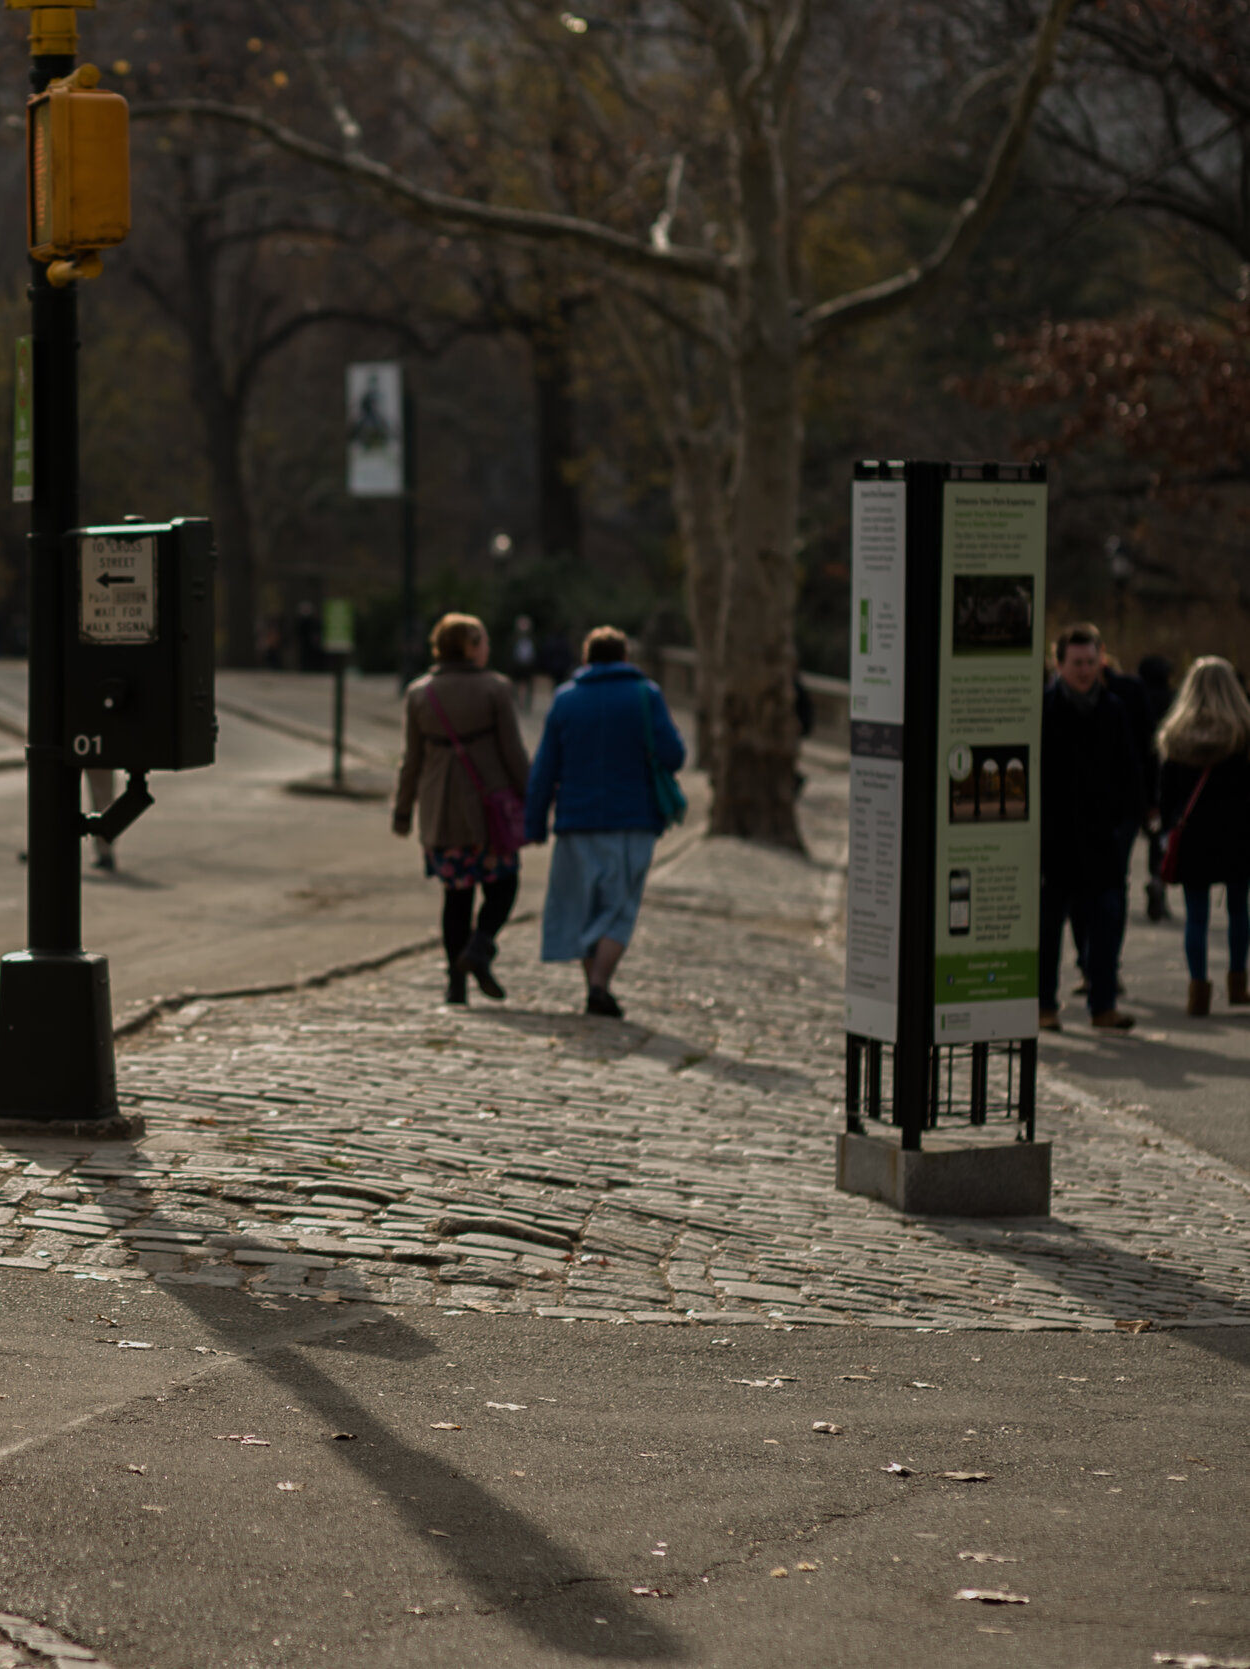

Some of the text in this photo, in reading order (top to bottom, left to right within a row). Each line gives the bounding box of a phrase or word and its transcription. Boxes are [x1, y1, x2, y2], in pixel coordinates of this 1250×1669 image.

[98, 556, 135, 568] STREET
[88, 591, 110, 602] PUSH
[94, 606, 142, 617] WAIT FOR
[85, 621, 149, 632] WALK SIGNAL
[73, 733, 103, 756] 01
